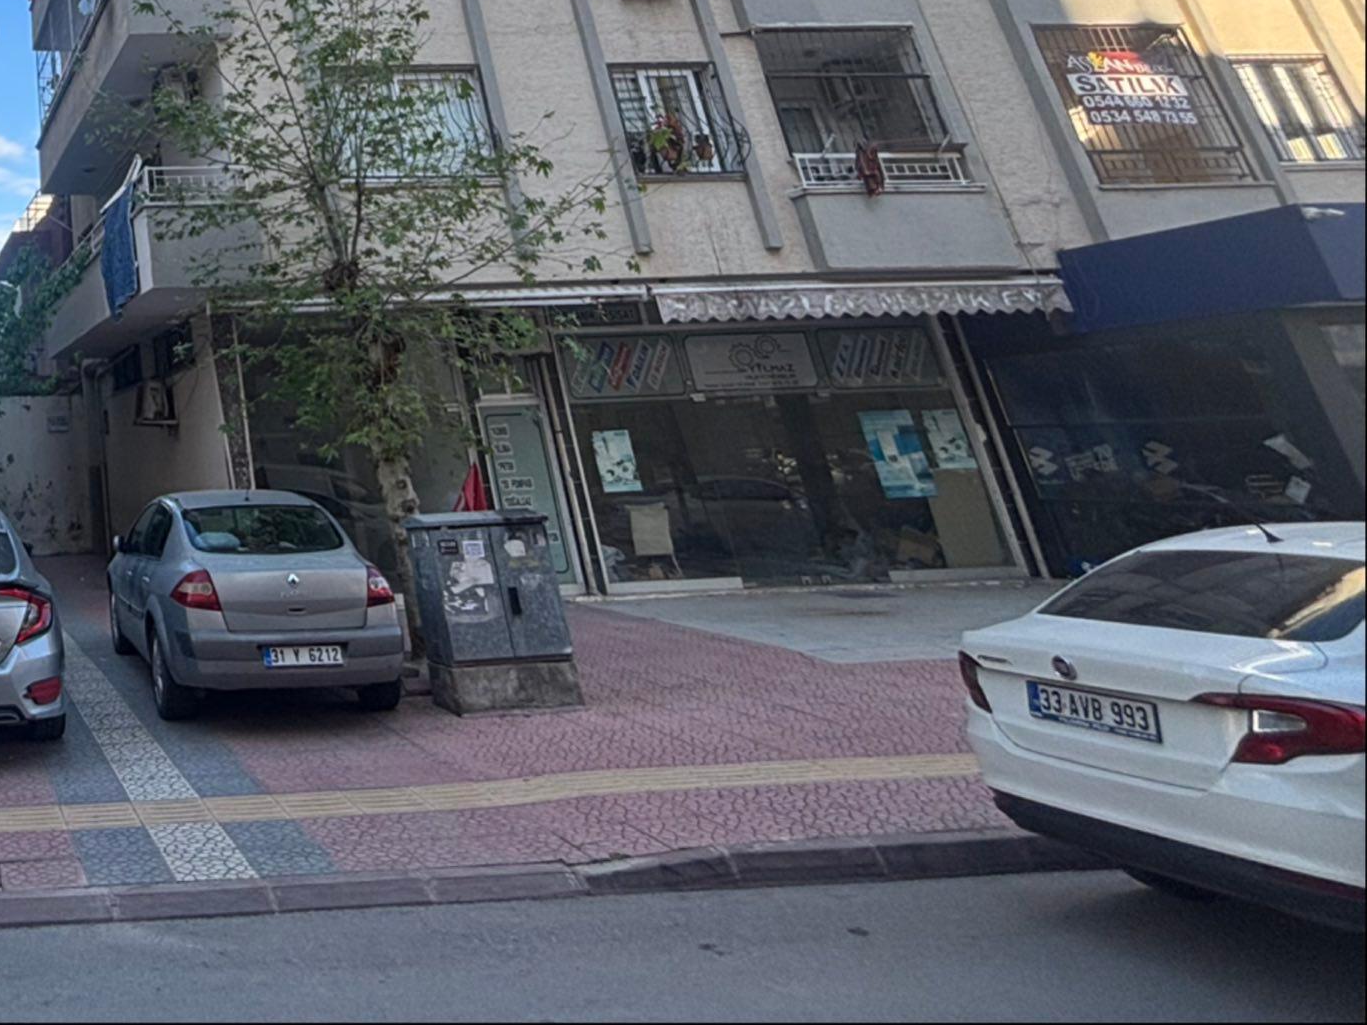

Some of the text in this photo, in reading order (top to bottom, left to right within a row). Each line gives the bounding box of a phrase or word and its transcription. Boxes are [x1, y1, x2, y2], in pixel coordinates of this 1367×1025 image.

[1075, 76, 1182, 93] SATILIK
[1089, 110, 1131, 123] 0534
[271, 647, 339, 663] 31 Y 6212
[1040, 688, 1063, 714] 33
[1069, 693, 1103, 721] AVB
[1111, 701, 1150, 731] 993
